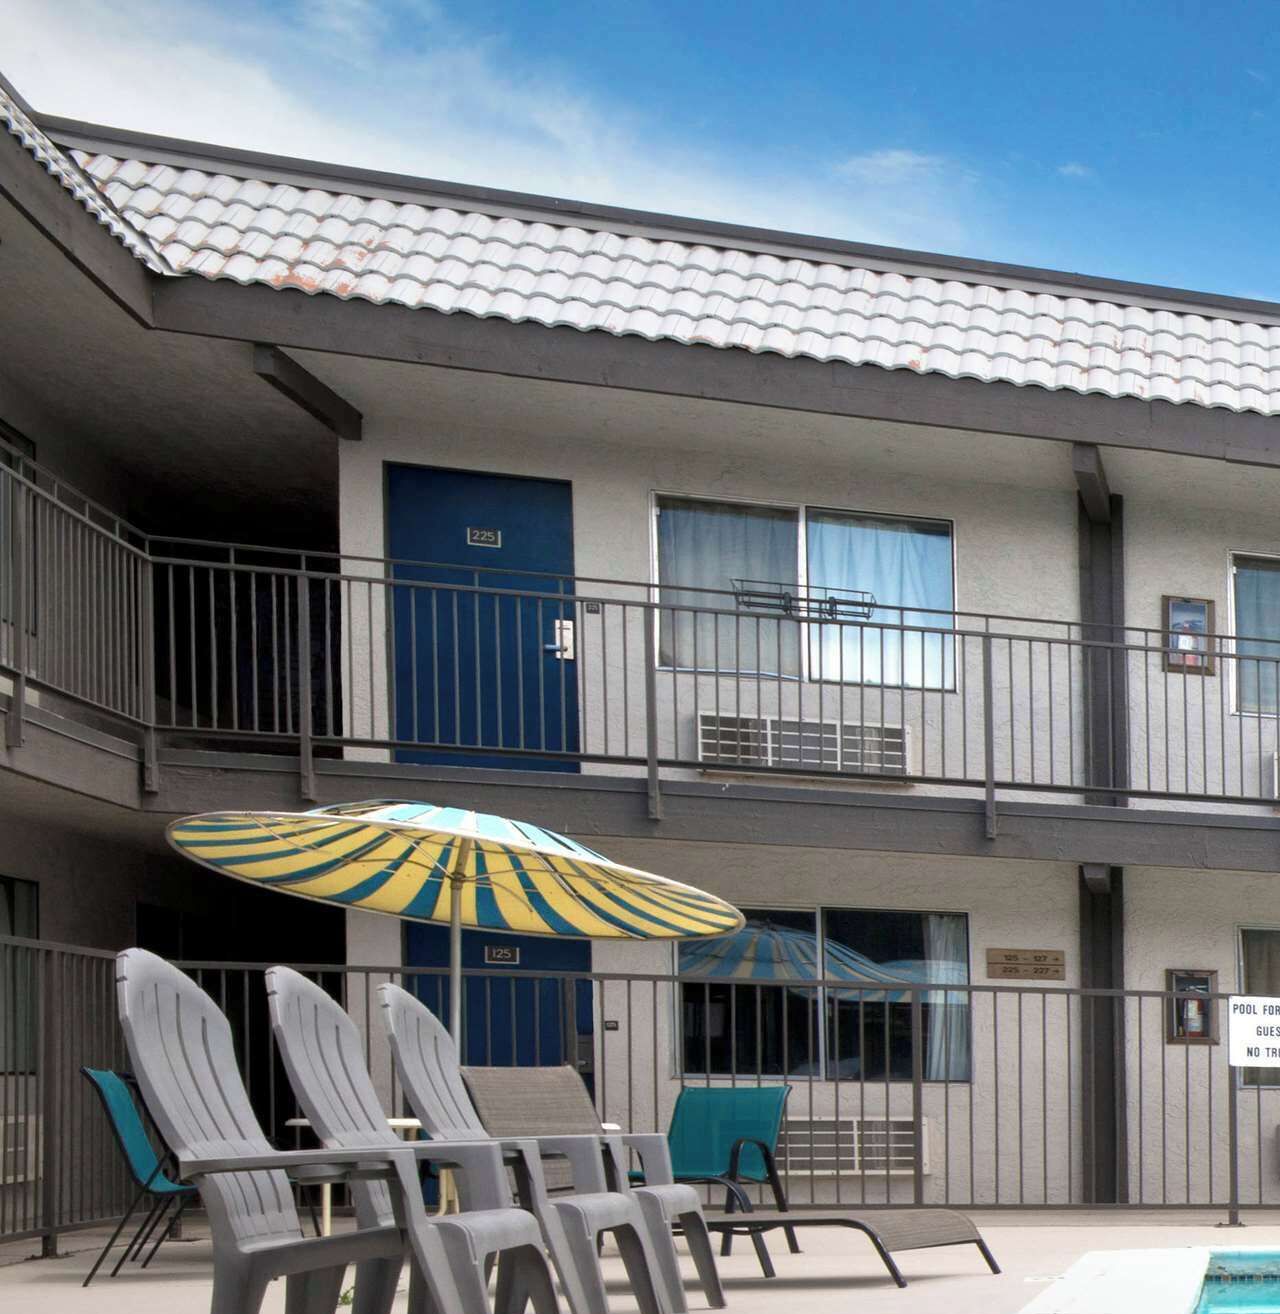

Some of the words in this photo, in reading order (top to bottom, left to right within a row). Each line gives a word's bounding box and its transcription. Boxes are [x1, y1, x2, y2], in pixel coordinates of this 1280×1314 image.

[472, 530, 496, 542] 225
[492, 948, 512, 959] 125
[1233, 1004, 1257, 1015] POOL
[1263, 1005, 1280, 1015] FOR
[1247, 1047, 1260, 1057] NO
